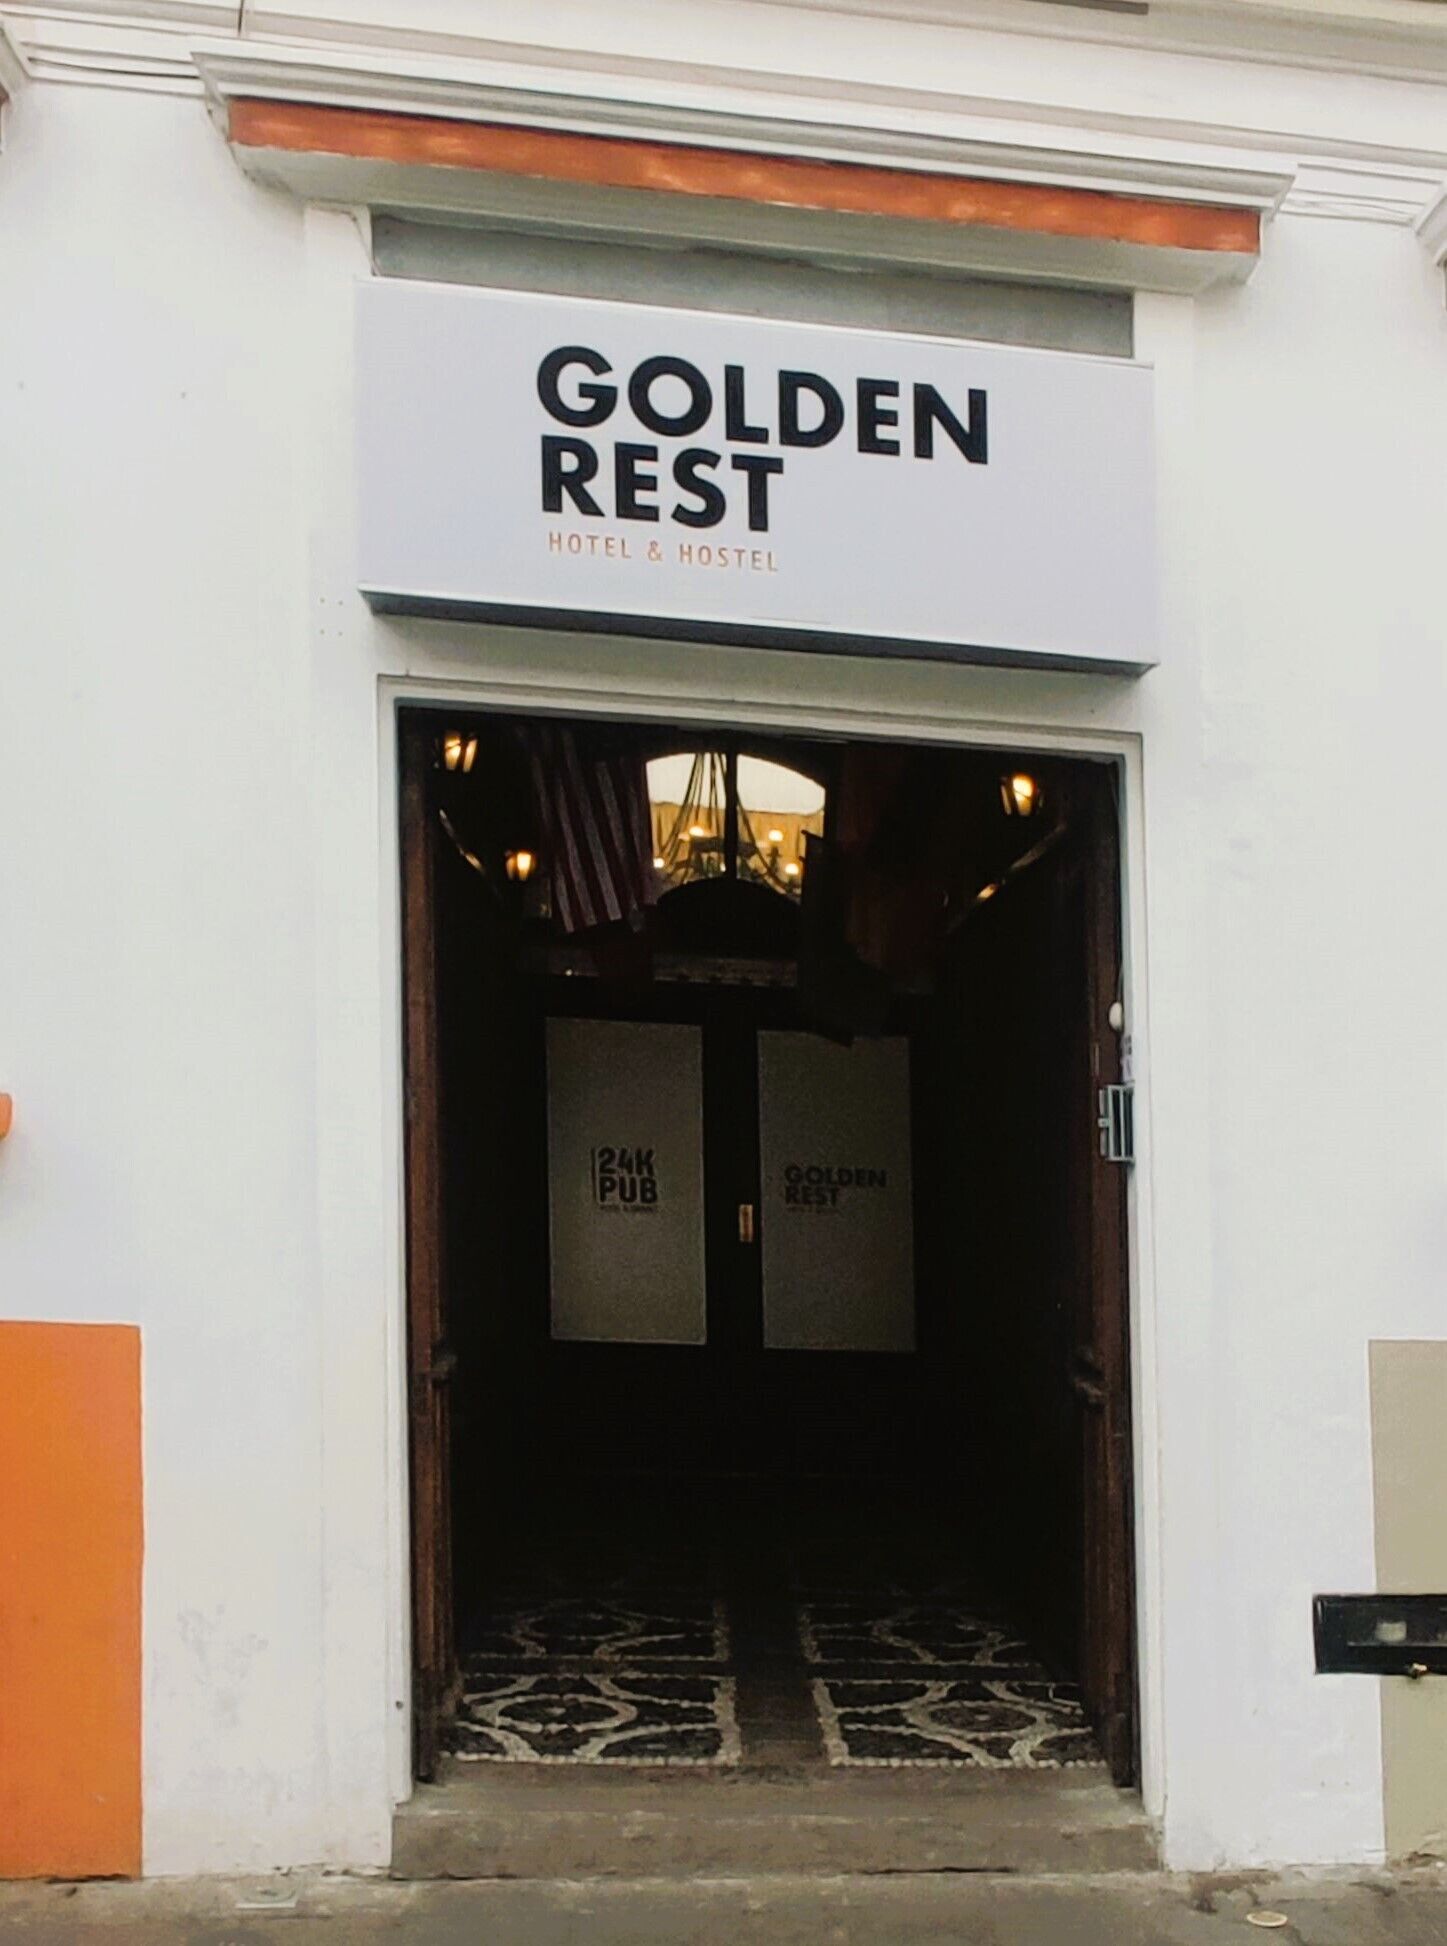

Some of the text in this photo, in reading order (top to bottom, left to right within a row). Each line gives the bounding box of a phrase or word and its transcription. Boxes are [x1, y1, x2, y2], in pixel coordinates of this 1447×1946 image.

[537, 345, 988, 465] GOLDEN
[541, 434, 784, 532] REST
[549, 531, 778, 572] HOTEL & HOSTEL
[598, 1146, 654, 1176] 24K
[599, 1176, 657, 1204] PUB
[784, 1165, 887, 1188] GOLDEN
[785, 1185, 840, 1208] REST
